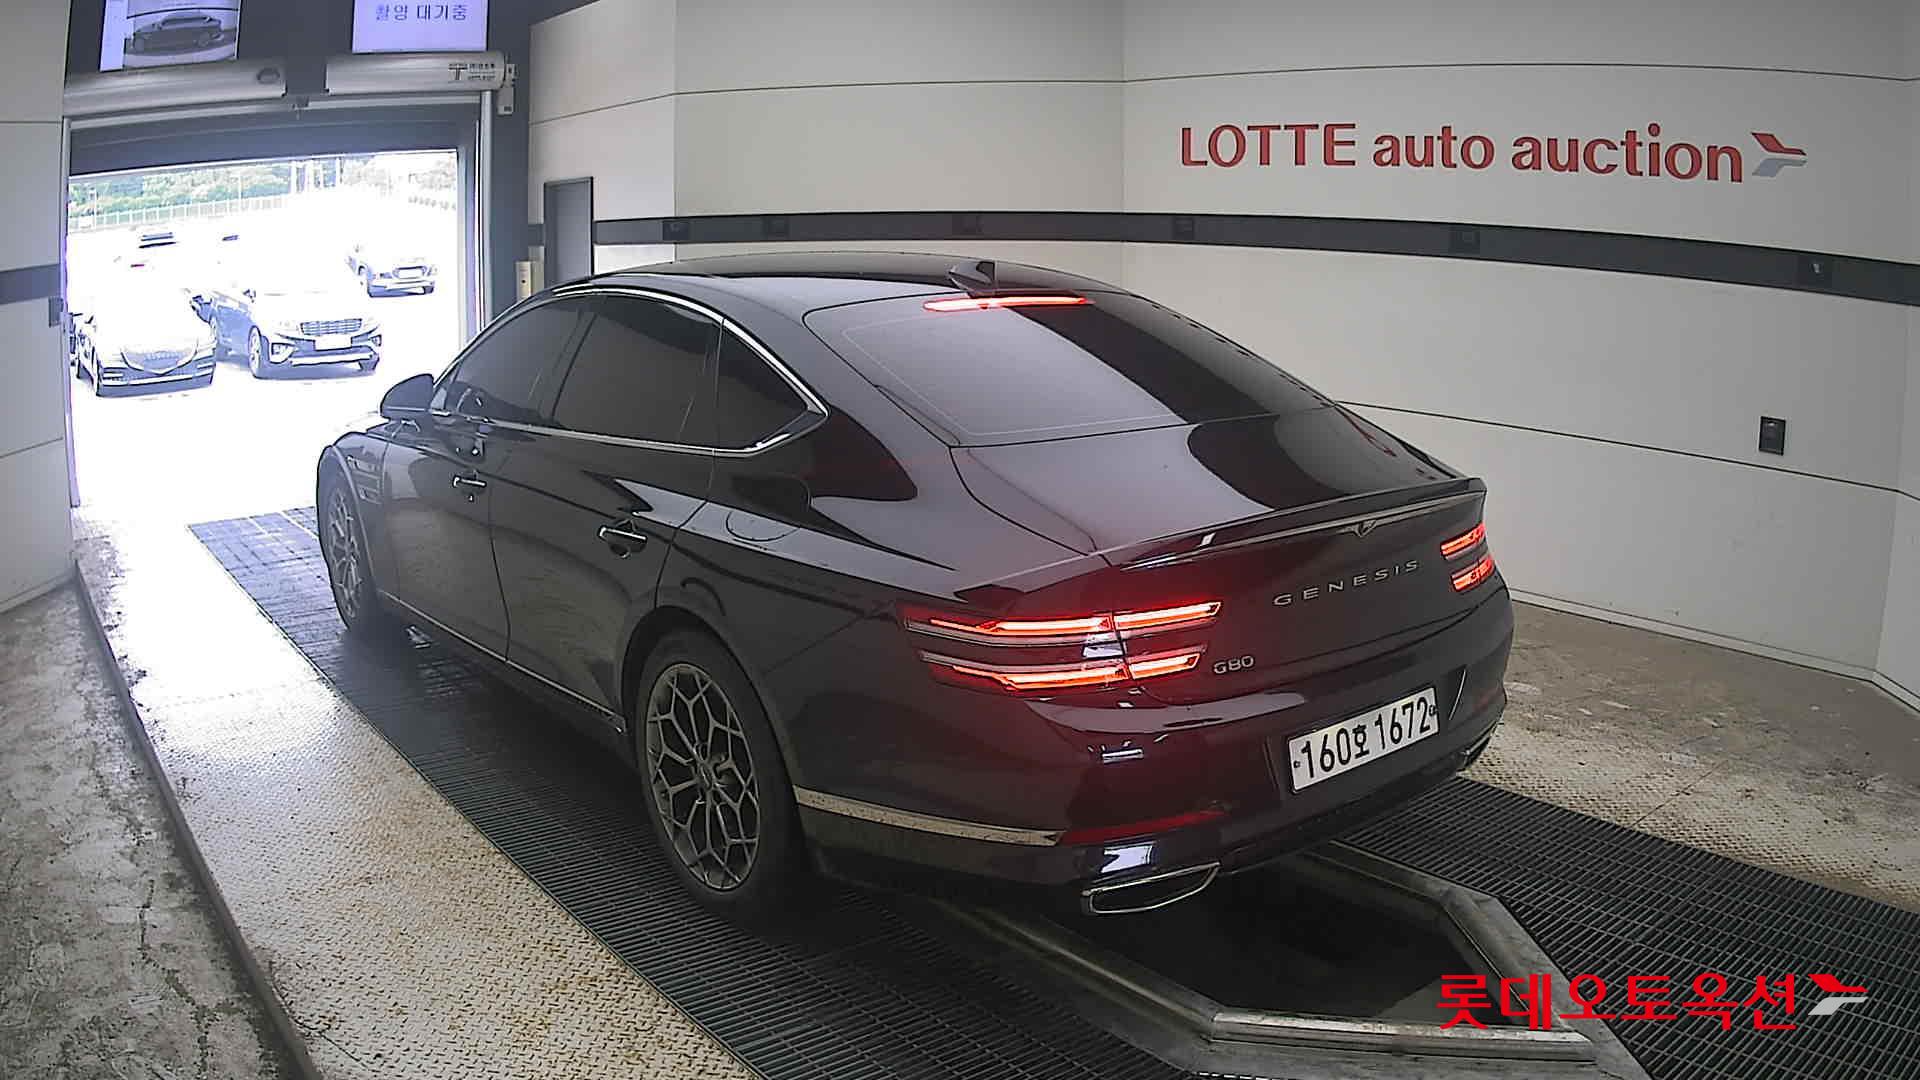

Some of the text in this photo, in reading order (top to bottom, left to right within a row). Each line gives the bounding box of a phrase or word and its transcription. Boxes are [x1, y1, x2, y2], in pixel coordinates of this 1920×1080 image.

[416, 4, 467, 21] 대기중
[1180, 122, 1744, 184] LOTTE auto auction
[1273, 559, 1419, 606] GENESIS
[1213, 655, 1255, 675] G80
[1301, 696, 1431, 779] 160호 1672
